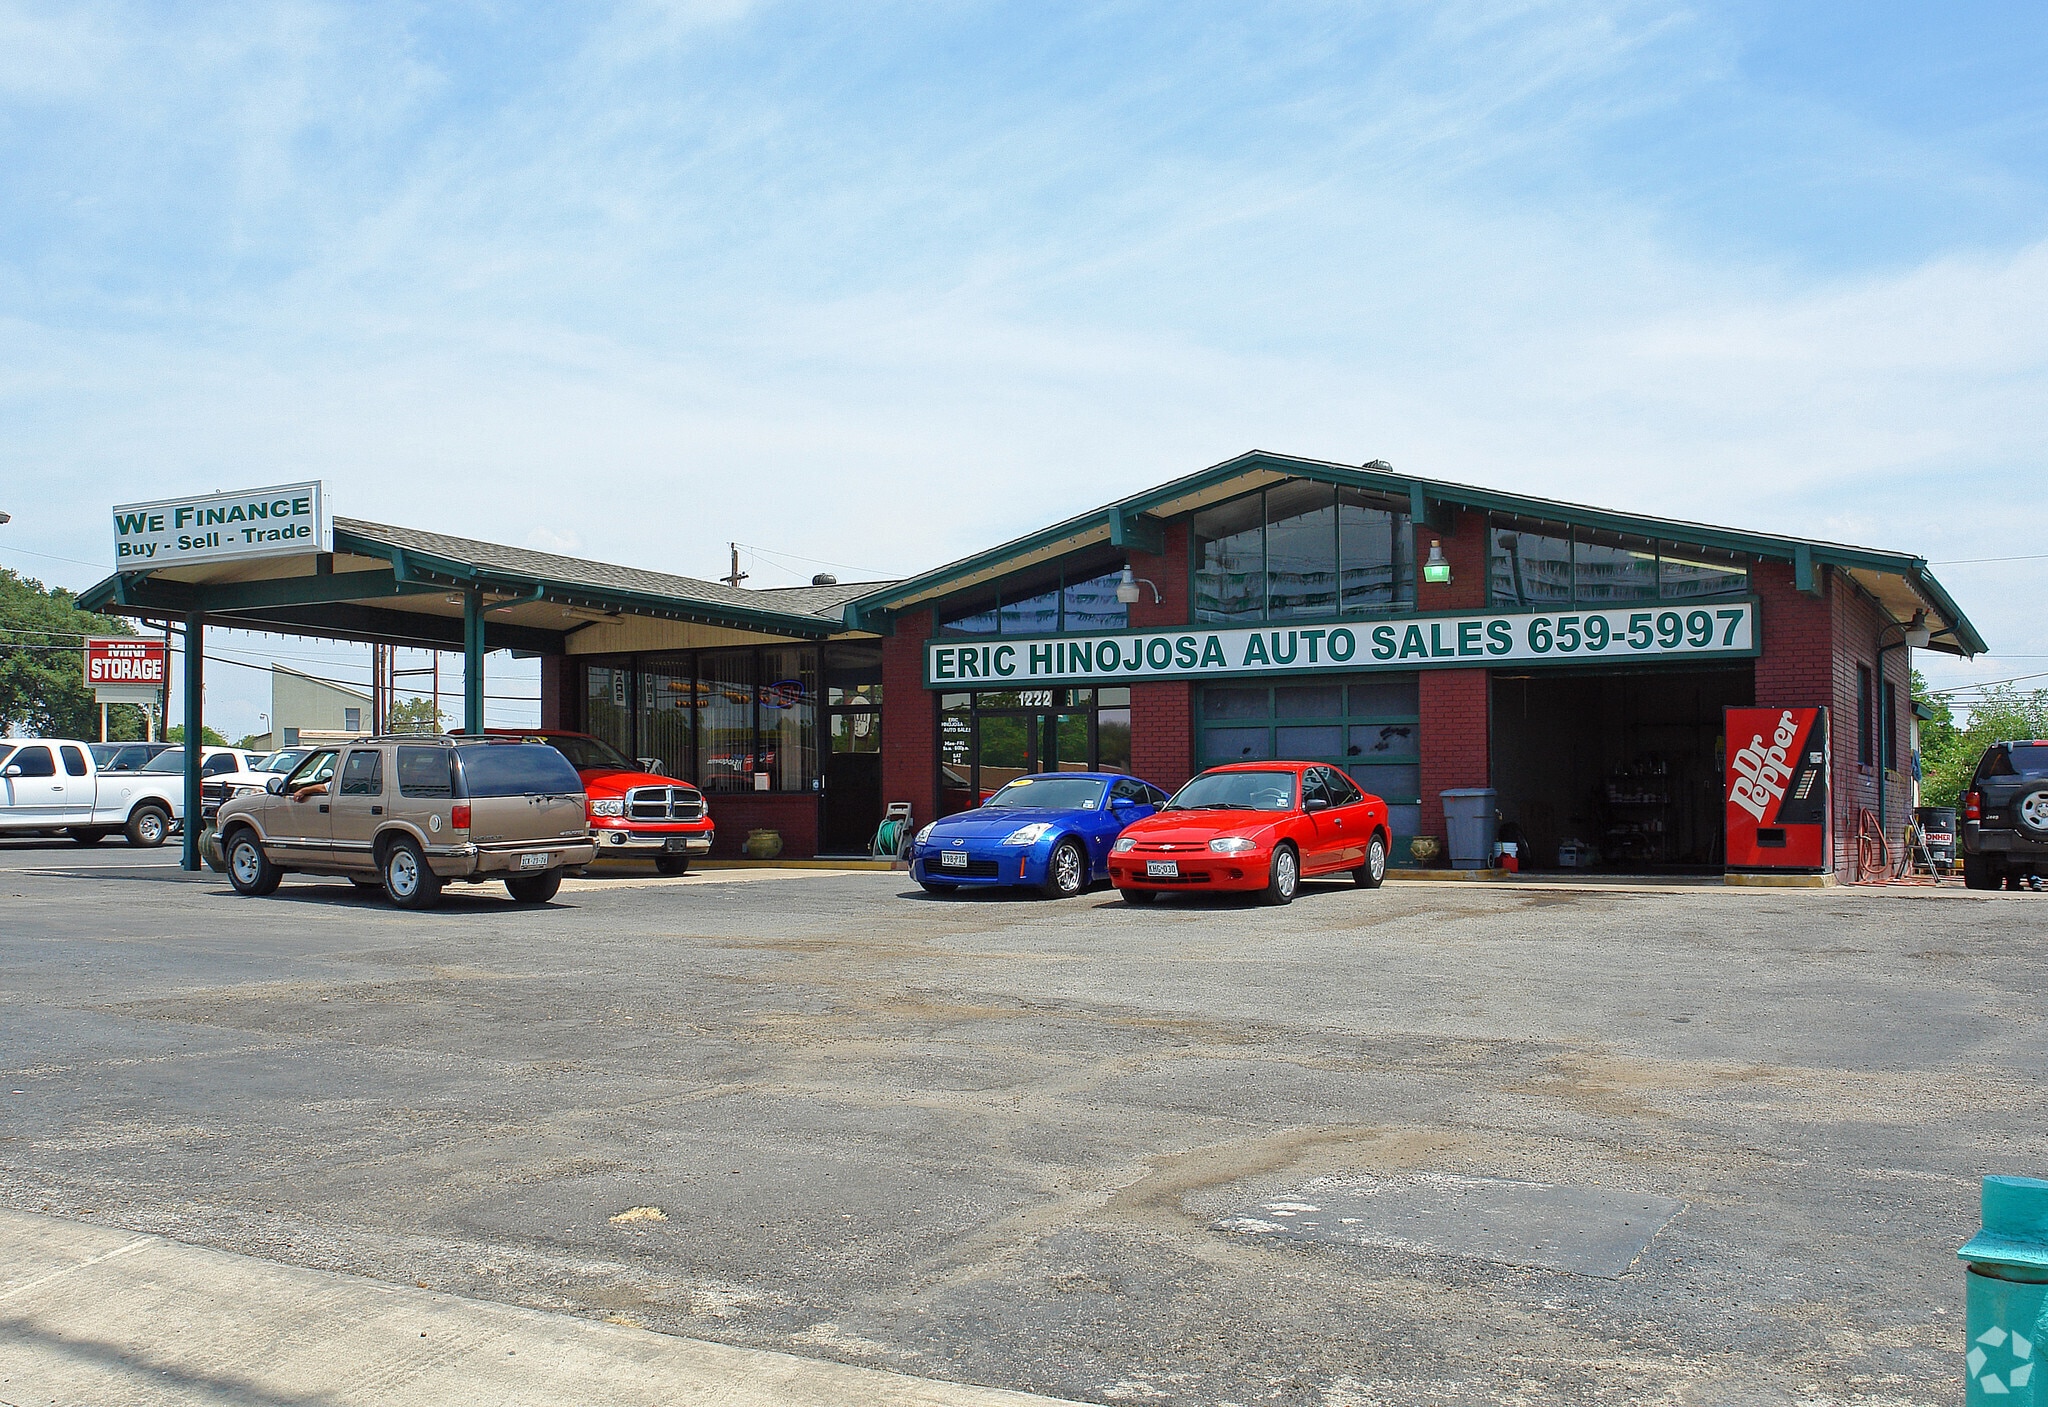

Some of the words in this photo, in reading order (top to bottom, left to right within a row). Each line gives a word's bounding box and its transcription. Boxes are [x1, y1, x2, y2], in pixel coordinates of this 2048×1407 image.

[174, 497, 311, 529] FINANCE
[118, 542, 158, 558] Buy
[177, 532, 220, 551] Sell
[241, 523, 311, 544] Trade
[107, 643, 146, 658] MINI
[935, 645, 1016, 679] ERIC
[1028, 635, 1227, 675] HINOJOSA
[1242, 628, 1357, 666] AUTO
[1371, 619, 1513, 660] SALES
[1527, 608, 1744, 654] 659-5997
[91, 657, 162, 680] STORAGE
[1018, 689, 1051, 707] 1222
[1728, 710, 1798, 824] Pepper
[1732, 734, 1768, 785] Dr
